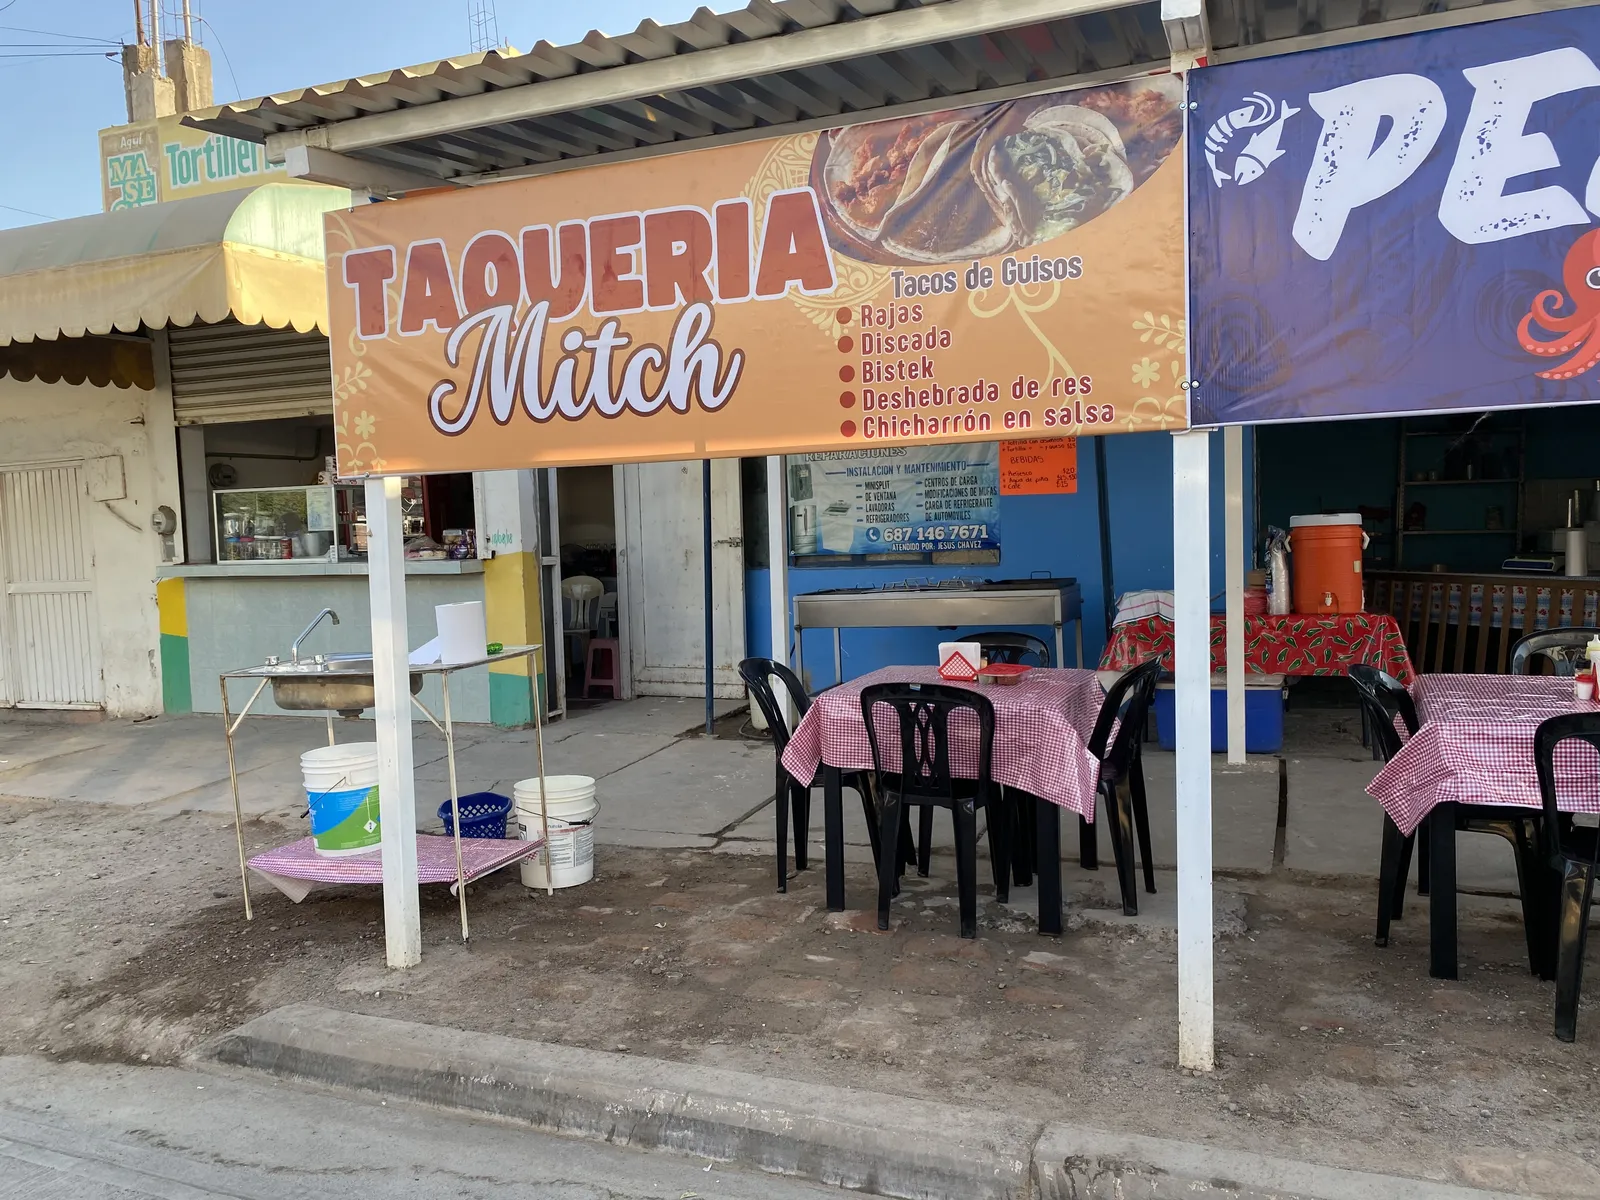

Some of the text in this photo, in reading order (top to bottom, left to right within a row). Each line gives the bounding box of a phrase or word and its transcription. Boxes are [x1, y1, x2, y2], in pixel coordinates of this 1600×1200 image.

[1291, 45, 1600, 262] PE
[342, 186, 838, 341] TAQUERIA
[890, 254, 1084, 299] Tacos de Guisos
[860, 302, 924, 331] Rajas
[860, 325, 952, 356] Discada
[427, 299, 746, 437] Mitch
[861, 355, 934, 384] Bistek
[862, 374, 1093, 412] Deshebrada de res
[862, 400, 1115, 440] Chicharrón en salsa
[1010, 456, 1044, 465] BEBIDAS
[846, 461, 967, 477] INSTALACION Y MANTENIMIENTO
[1063, 467, 1075, 475] $20
[864, 480, 890, 490] MINISPLIT
[924, 476, 978, 488] CENTROS DE CARGA
[864, 491, 897, 501] DE VENTANA
[924, 488, 968, 499] MODIFICACIONES
[969, 487, 978, 497] DE
[865, 502, 895, 513] LAVADORAS
[924, 498, 993, 511] CARGA DE REFRIGERANTE
[865, 513, 910, 524] REFRIGERADORES
[925, 510, 971, 522] DE AUTOMOVILES
[883, 524, 989, 542] 687 146 7671
[892, 540, 982, 551] ATENDIDO POR: JESUS CHAVEZ
